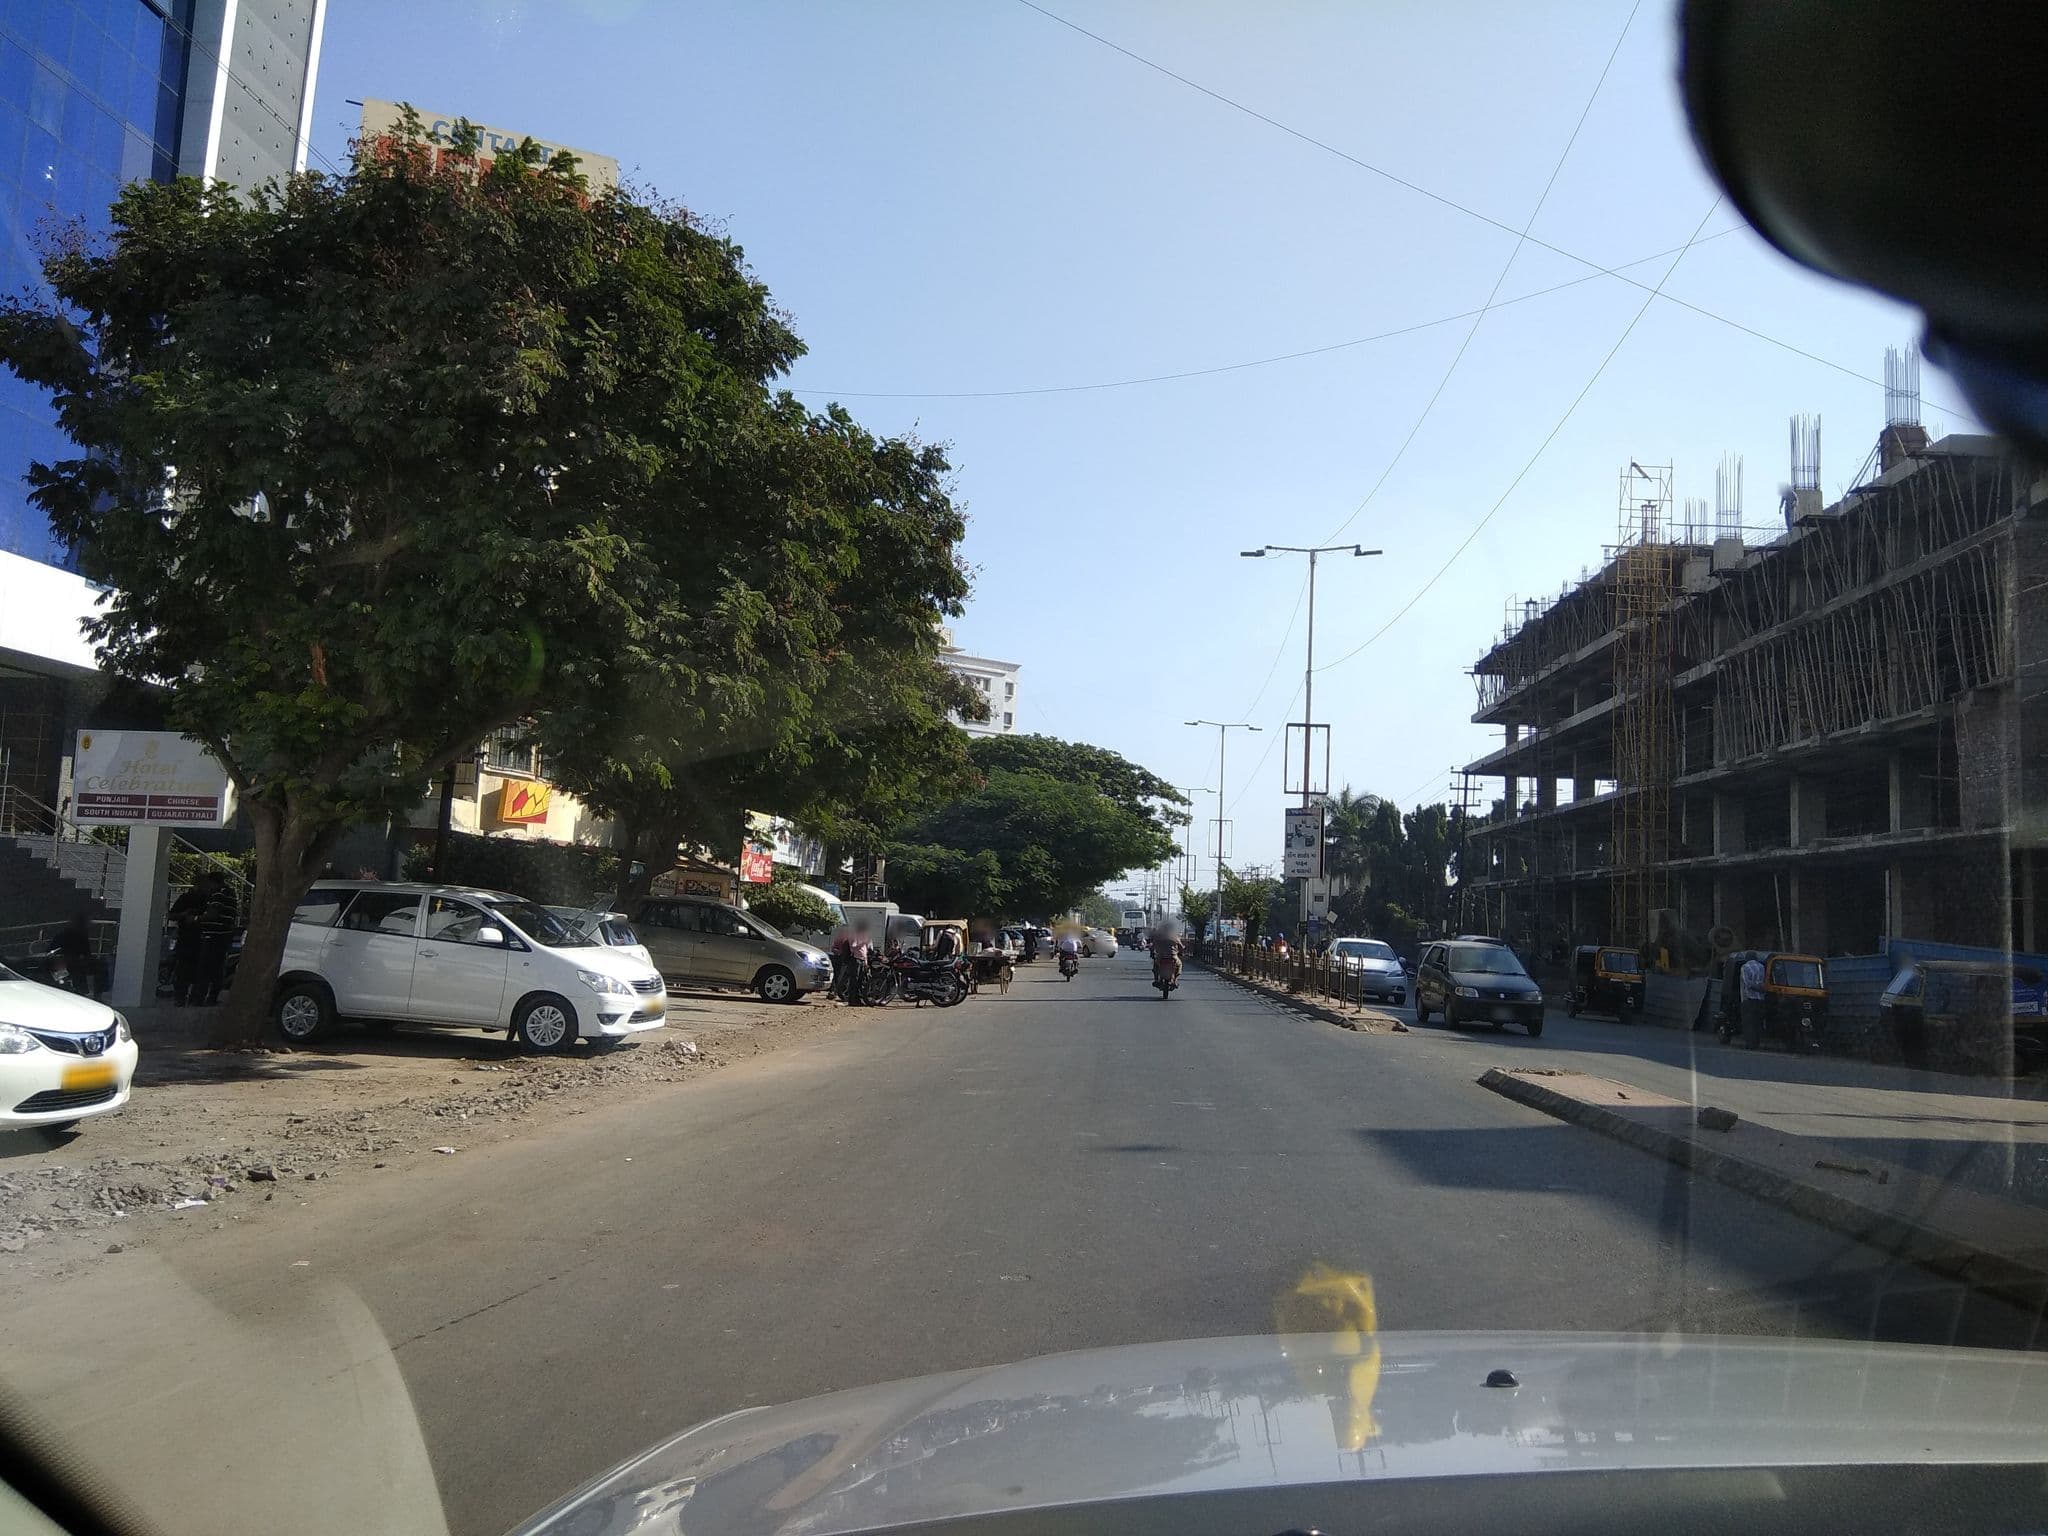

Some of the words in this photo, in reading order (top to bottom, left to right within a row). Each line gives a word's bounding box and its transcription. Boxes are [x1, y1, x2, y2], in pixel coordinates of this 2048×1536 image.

[432, 120, 554, 164] COTAT
[120, 759, 178, 775] Hotel
[96, 795, 129, 804] PUNJABI
[167, 797, 200, 807] CHINESE
[84, 808, 110, 817] SOUTH
[111, 809, 139, 818] INDIAN
[151, 809, 189, 819] GUJARATI
[190, 810, 213, 819] THALI
